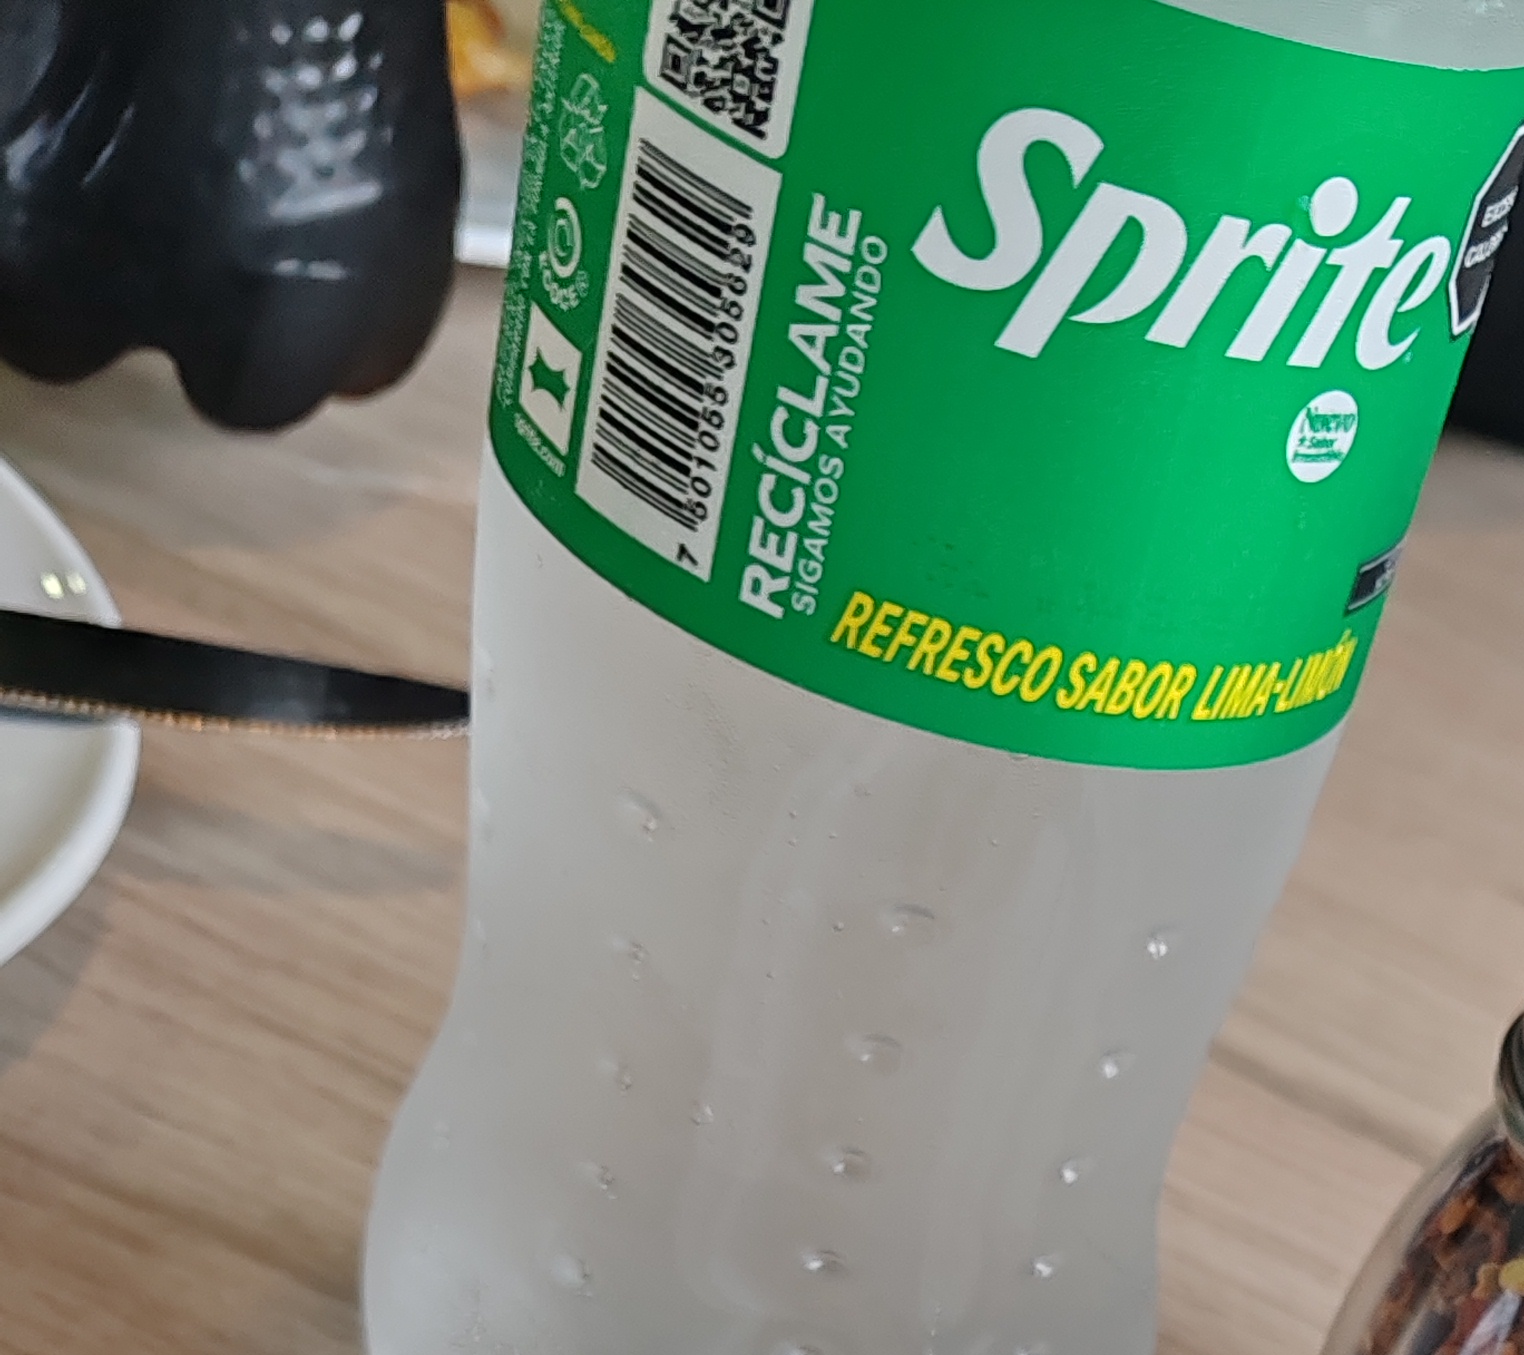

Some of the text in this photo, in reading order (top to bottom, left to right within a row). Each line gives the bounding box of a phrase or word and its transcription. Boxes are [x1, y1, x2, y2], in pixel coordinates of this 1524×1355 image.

[911, 107, 1451, 371] Sprite
[738, 192, 863, 620] RECÍCLAME
[791, 235, 888, 616] SIGAMOS AYUDANDO
[829, 590, 1063, 703] REFRESCO
[1055, 651, 1198, 720] SABOR
